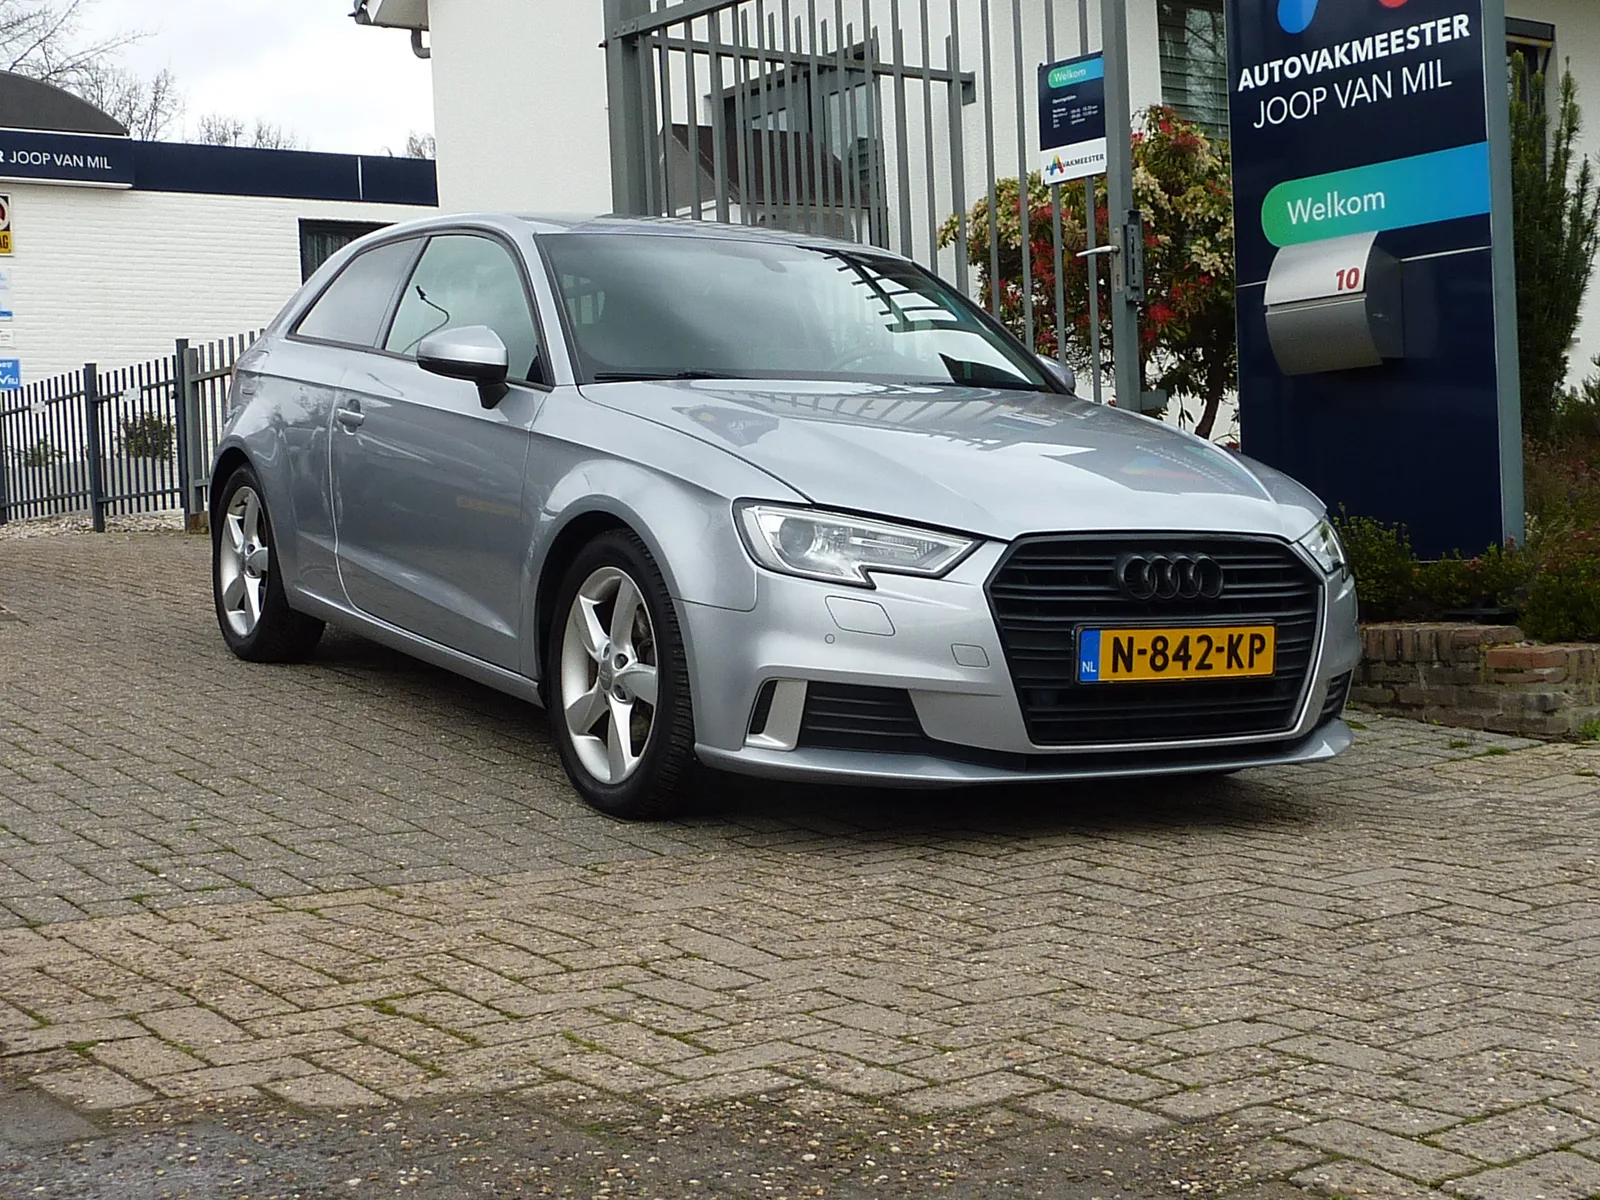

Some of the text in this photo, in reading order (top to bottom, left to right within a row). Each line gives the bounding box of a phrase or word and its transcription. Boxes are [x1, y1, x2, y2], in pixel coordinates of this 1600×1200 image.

[1237, 13, 1471, 92] AUTOVAKMEESTER
[1054, 68, 1087, 82] Welkom
[1253, 58, 1452, 129] JOOP VAN MIL
[10, 150, 51, 165] JOOP
[53, 153, 84, 168] VAN
[87, 155, 112, 169] MIL
[1287, 190, 1386, 225] Welkom
[1336, 267, 1361, 291] 10
[1082, 633, 1267, 673] NL N-842-KP
